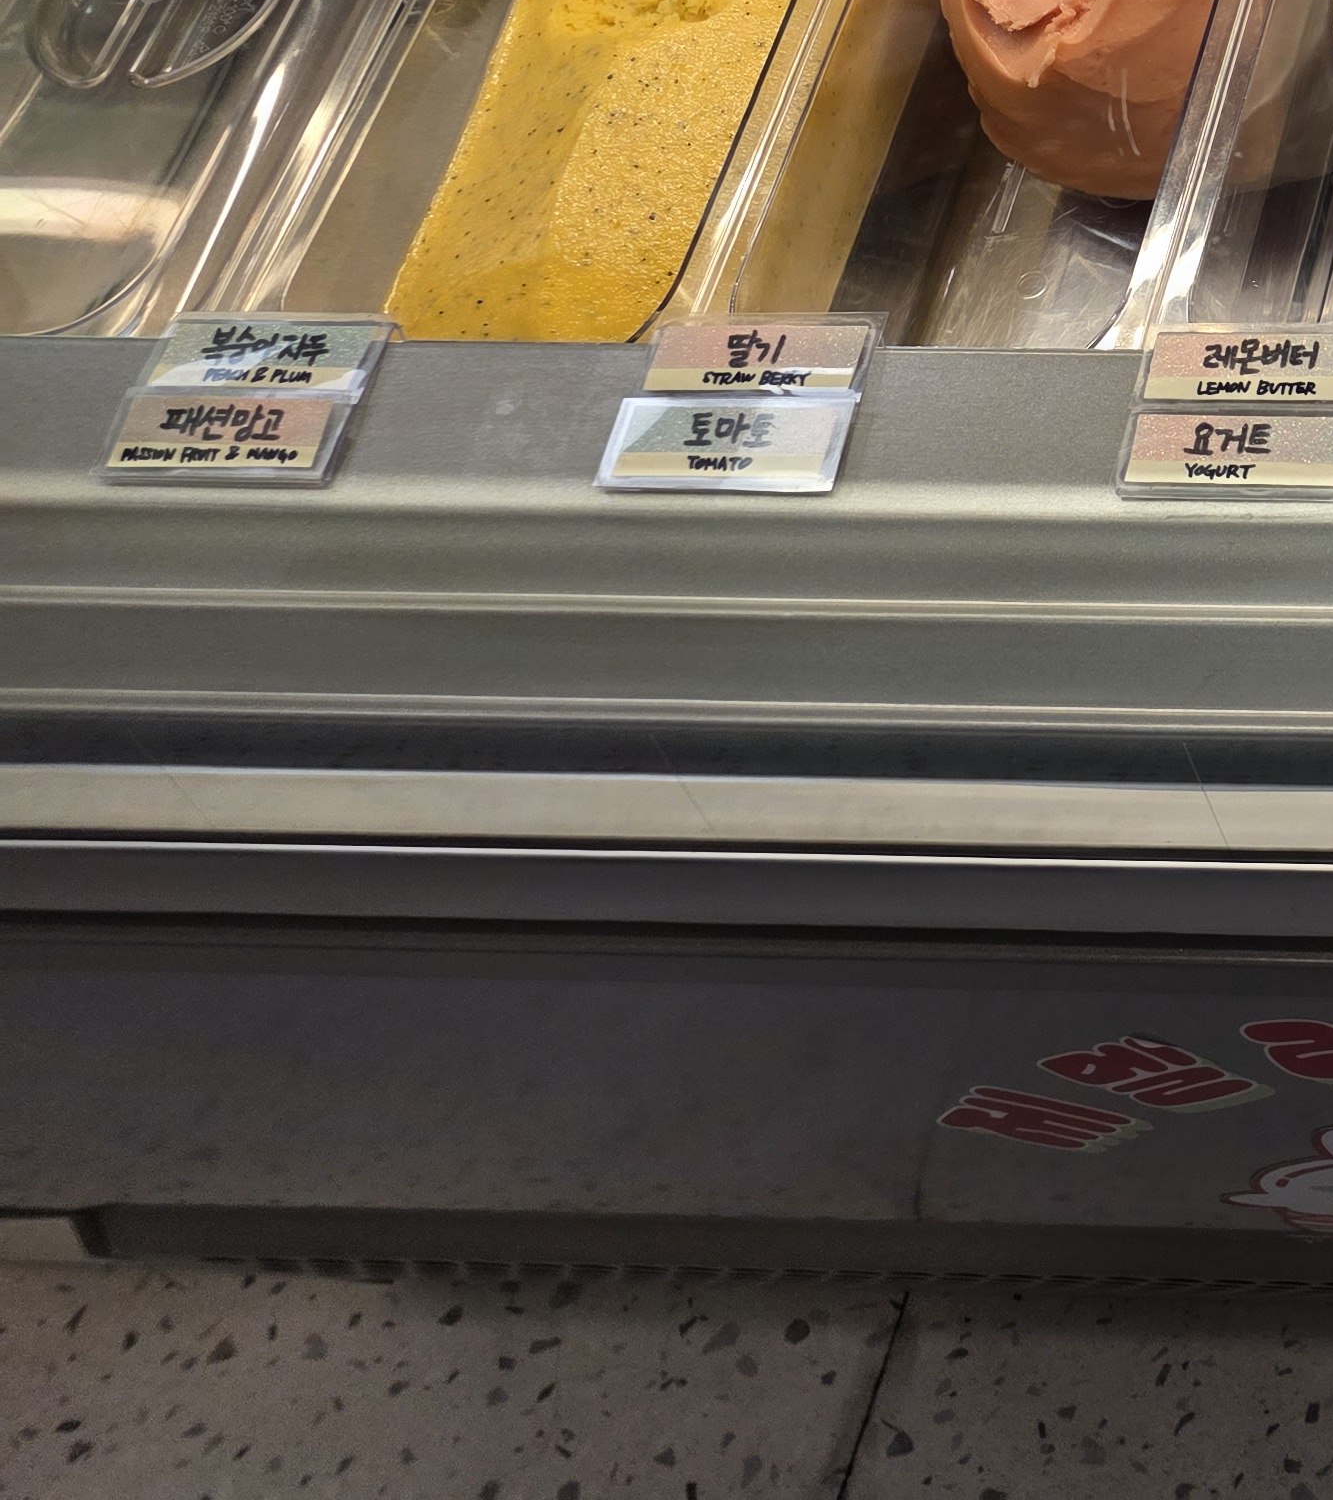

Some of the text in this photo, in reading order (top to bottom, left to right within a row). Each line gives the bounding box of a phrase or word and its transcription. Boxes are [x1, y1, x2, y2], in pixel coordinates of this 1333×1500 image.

[727, 329, 787, 368] 딸기
[1202, 338, 1320, 375] 레몬버터
[269, 368, 312, 383] PLUM
[702, 371, 756, 385] STRAW
[1196, 380, 1317, 396] LEMON BUTTER
[159, 404, 285, 442] 패션망고
[683, 411, 776, 448] 토마토
[1183, 422, 1272, 456] 요거트
[686, 455, 753, 471] TOMATO
[1184, 462, 1256, 480] YOGURT
